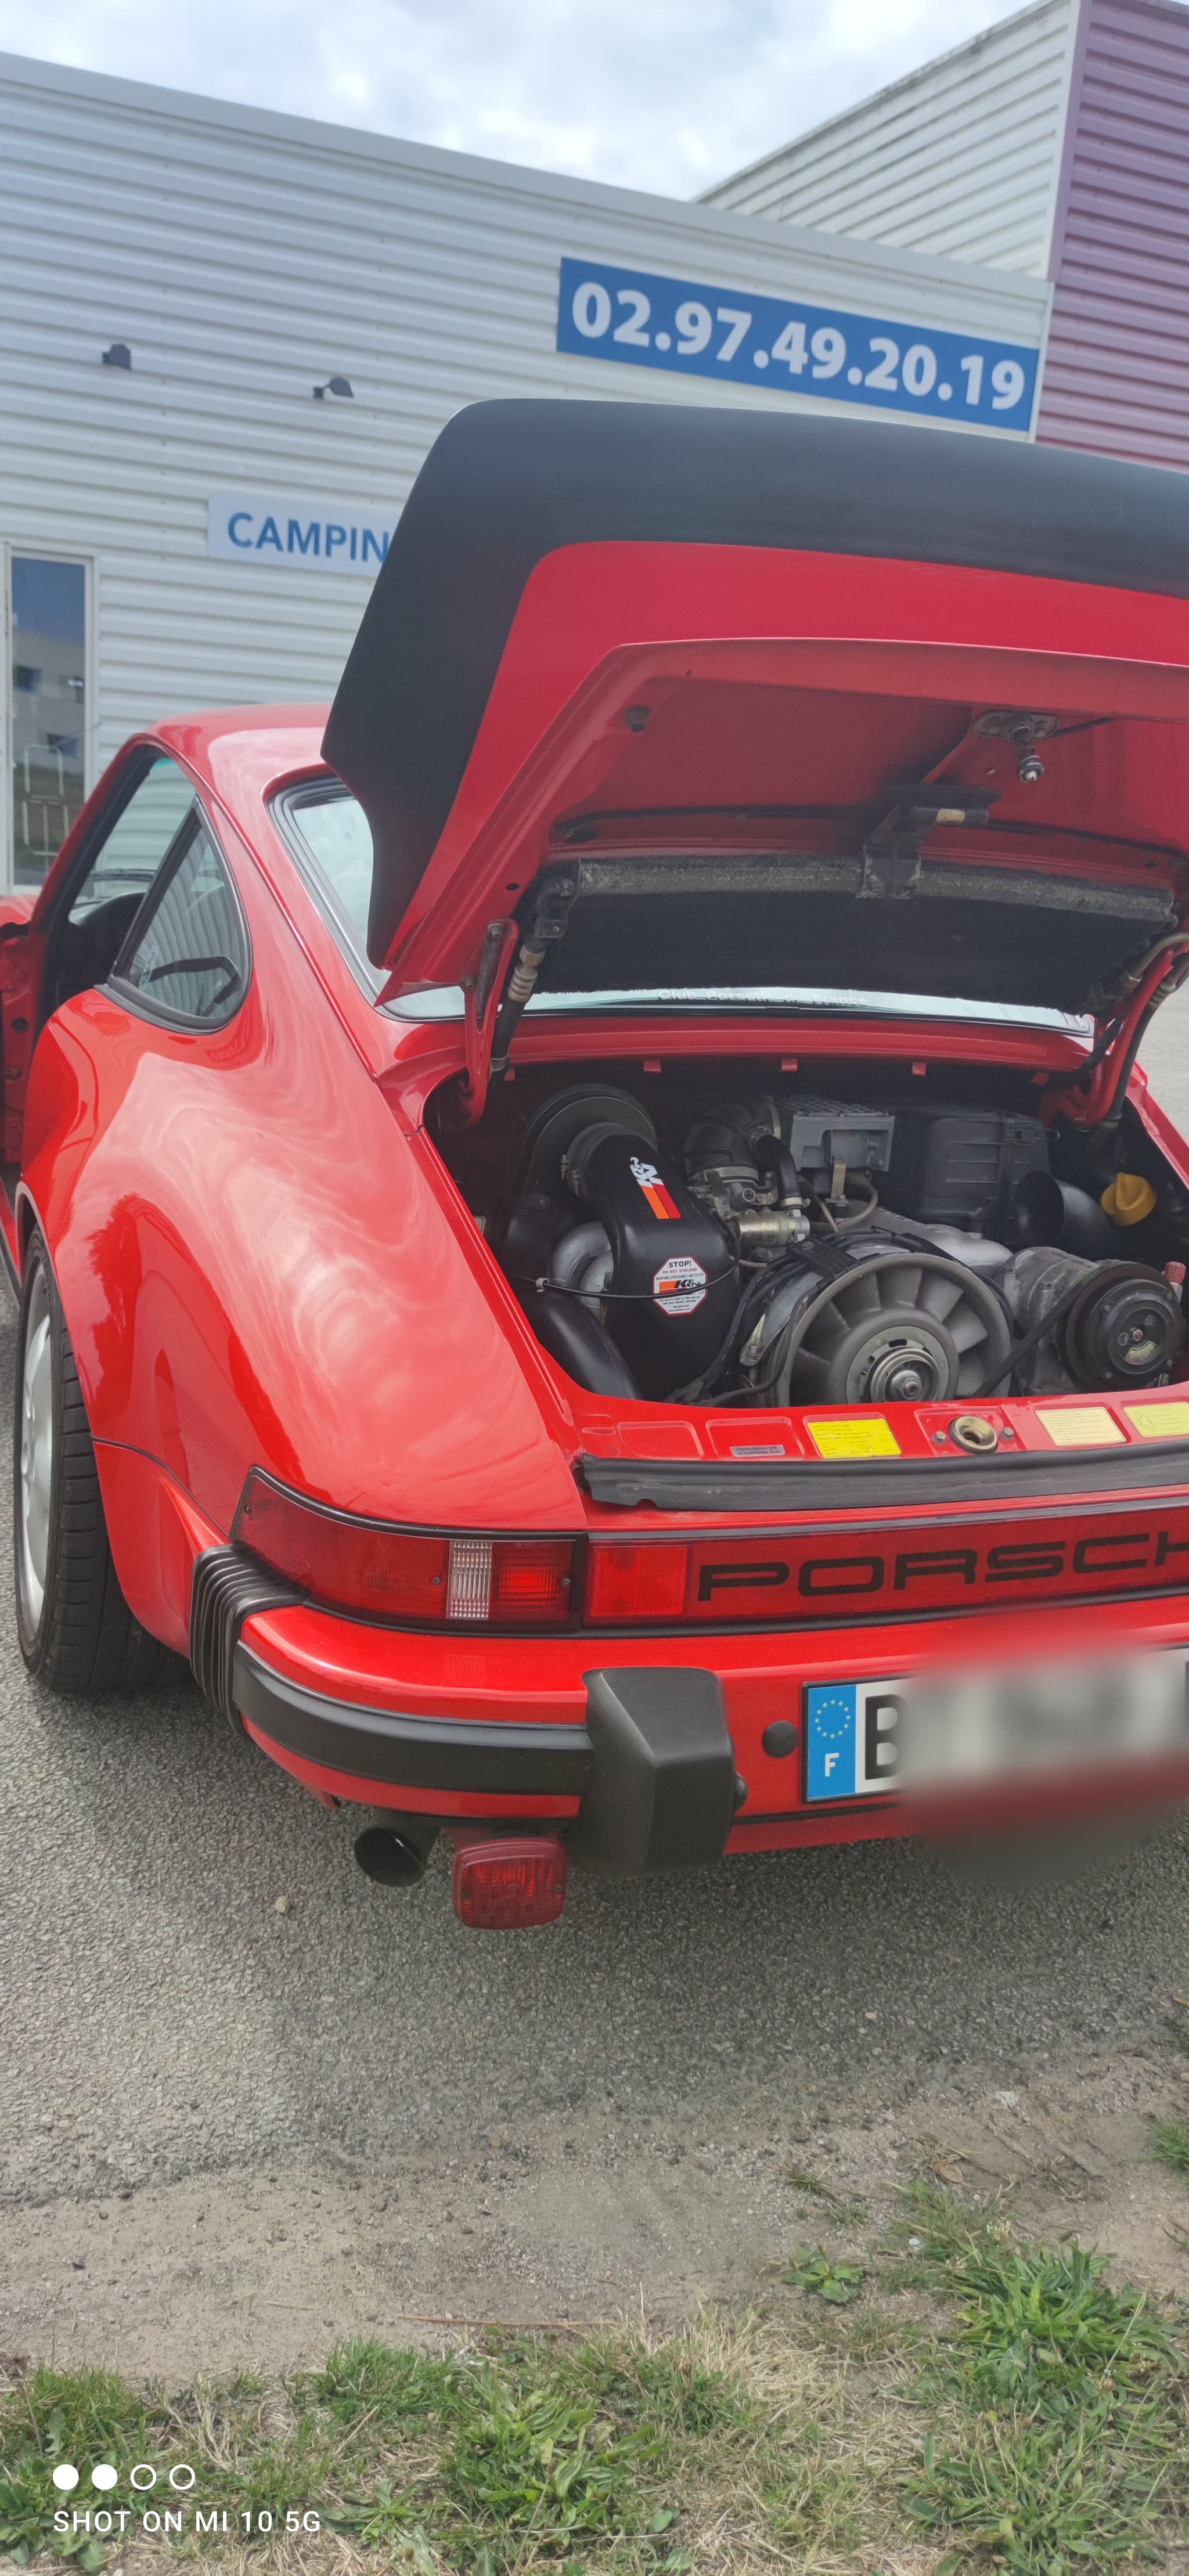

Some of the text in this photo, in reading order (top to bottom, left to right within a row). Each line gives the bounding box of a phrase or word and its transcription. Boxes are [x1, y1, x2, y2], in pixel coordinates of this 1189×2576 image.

[571, 282, 1026, 410] 02.97.49.20.19
[228, 512, 391, 563] CAMPIN
[658, 988, 696, 1000] Club
[812, 993, 867, 1005] France
[824, 1752, 839, 1777] F
